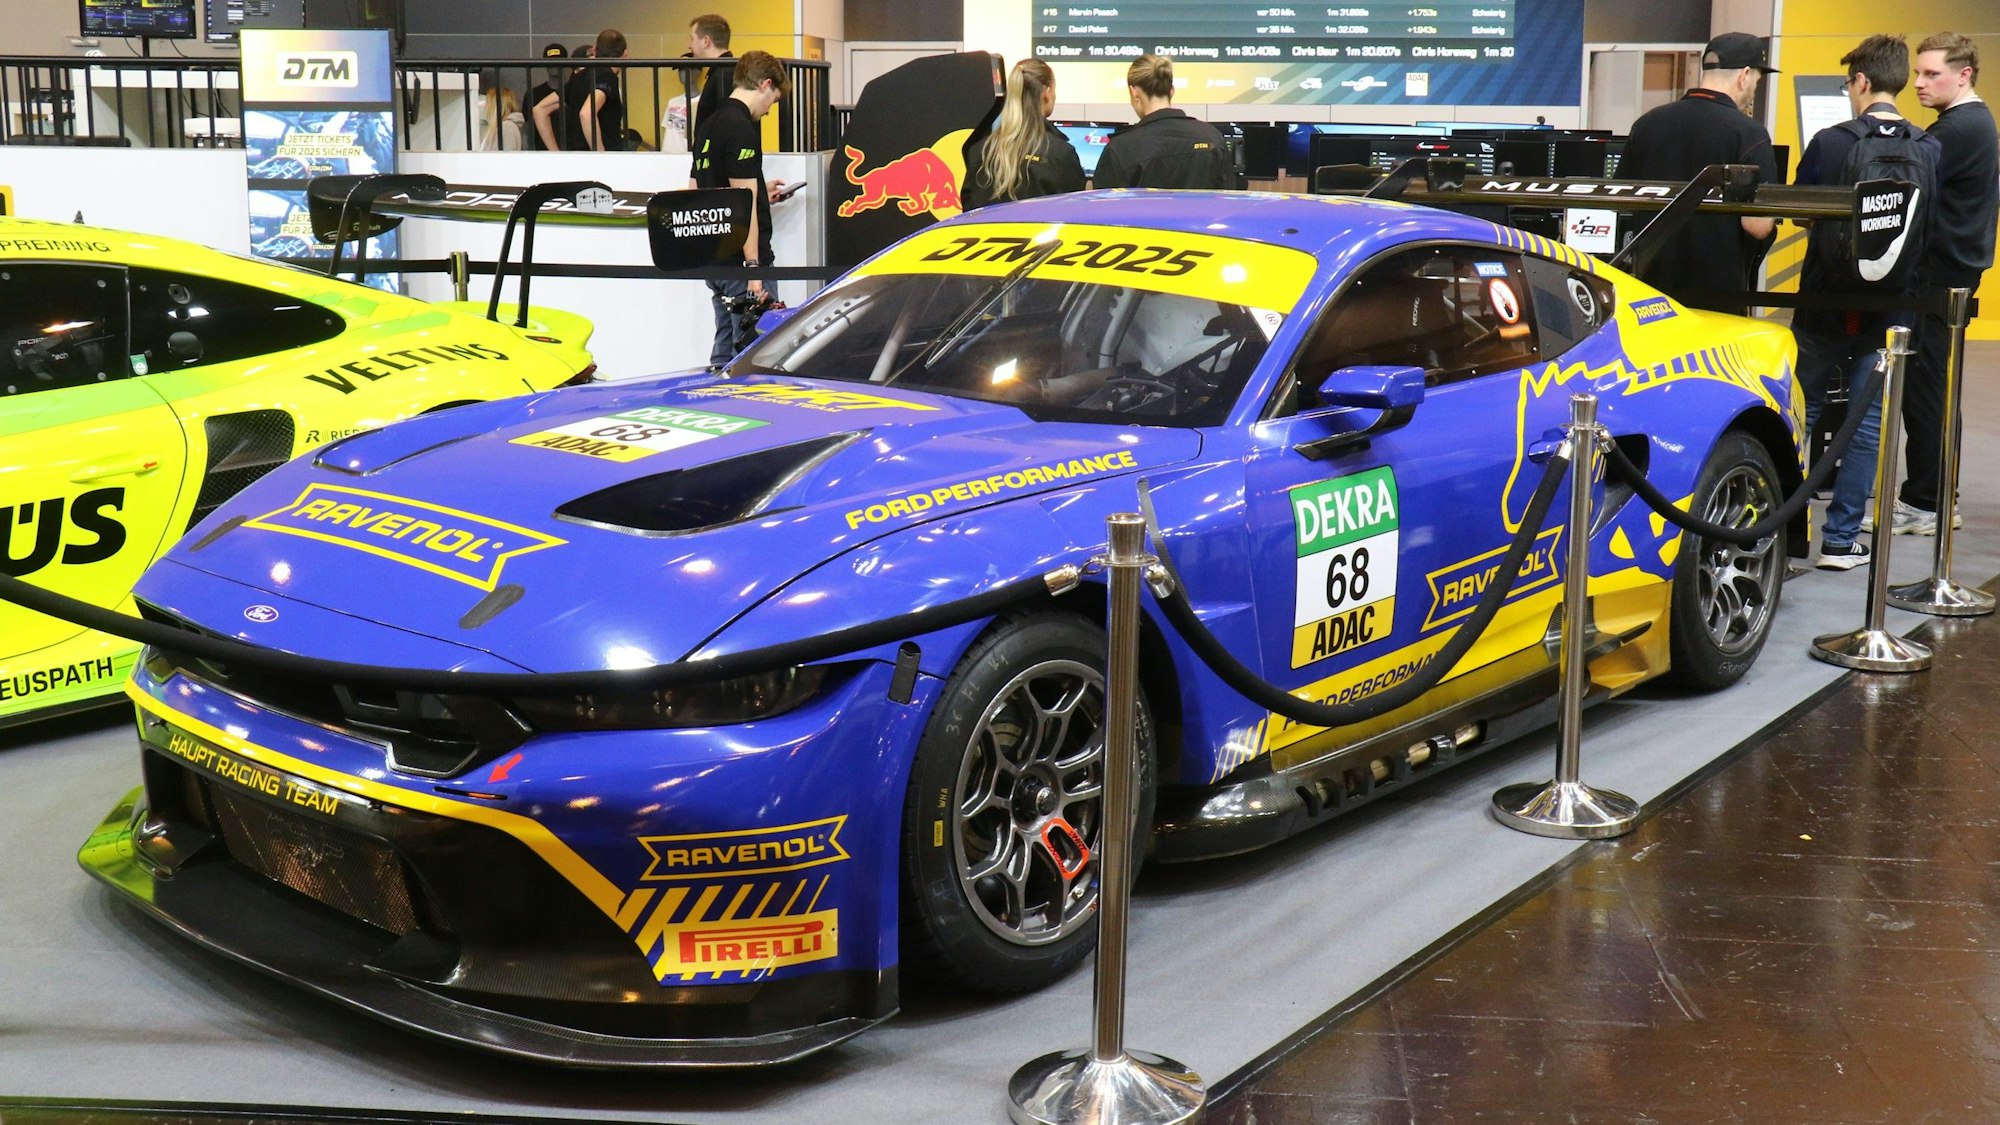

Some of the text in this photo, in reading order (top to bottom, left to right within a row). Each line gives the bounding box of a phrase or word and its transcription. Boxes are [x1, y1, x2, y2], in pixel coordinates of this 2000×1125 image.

[1035, 46, 1059, 56] Chris
[1089, 46, 1104, 56] 1m
[1155, 46, 1178, 56] Chris
[1225, 46, 1240, 56] 1m
[1292, 46, 1316, 56] Chris
[1345, 46, 1361, 57] 1m
[1412, 46, 1436, 57] Chris
[1483, 46, 1499, 57] 1m
[283, 58, 350, 80] DTM
[287, 135, 352, 144] JETZT TICKETS
[298, 147, 320, 156] 2025
[322, 147, 361, 156] SICHERN
[1481, 181, 1673, 198] MUSTA
[673, 223, 731, 238] WORKWEAR
[1861, 214, 1901, 233] WORKWEAR
[0, 239, 111, 253] PREINING
[921, 236, 1215, 277] DTM 2025
[1476, 264, 1506, 276] NOTICE
[1634, 301, 1673, 320] RAVENOL
[303, 343, 510, 395] VELTINS
[614, 406, 750, 434] DEKRA
[589, 423, 671, 442] 68
[532, 435, 629, 456] ADAC
[1295, 478, 1396, 545] DEKRA
[1326, 547, 1370, 609] 68
[1311, 606, 1375, 661] ADAC
[0, 656, 113, 701] EUSPATH
[169, 733, 339, 816] HAUPT RACING TEAM
[678, 920, 824, 964] PIRELLI
